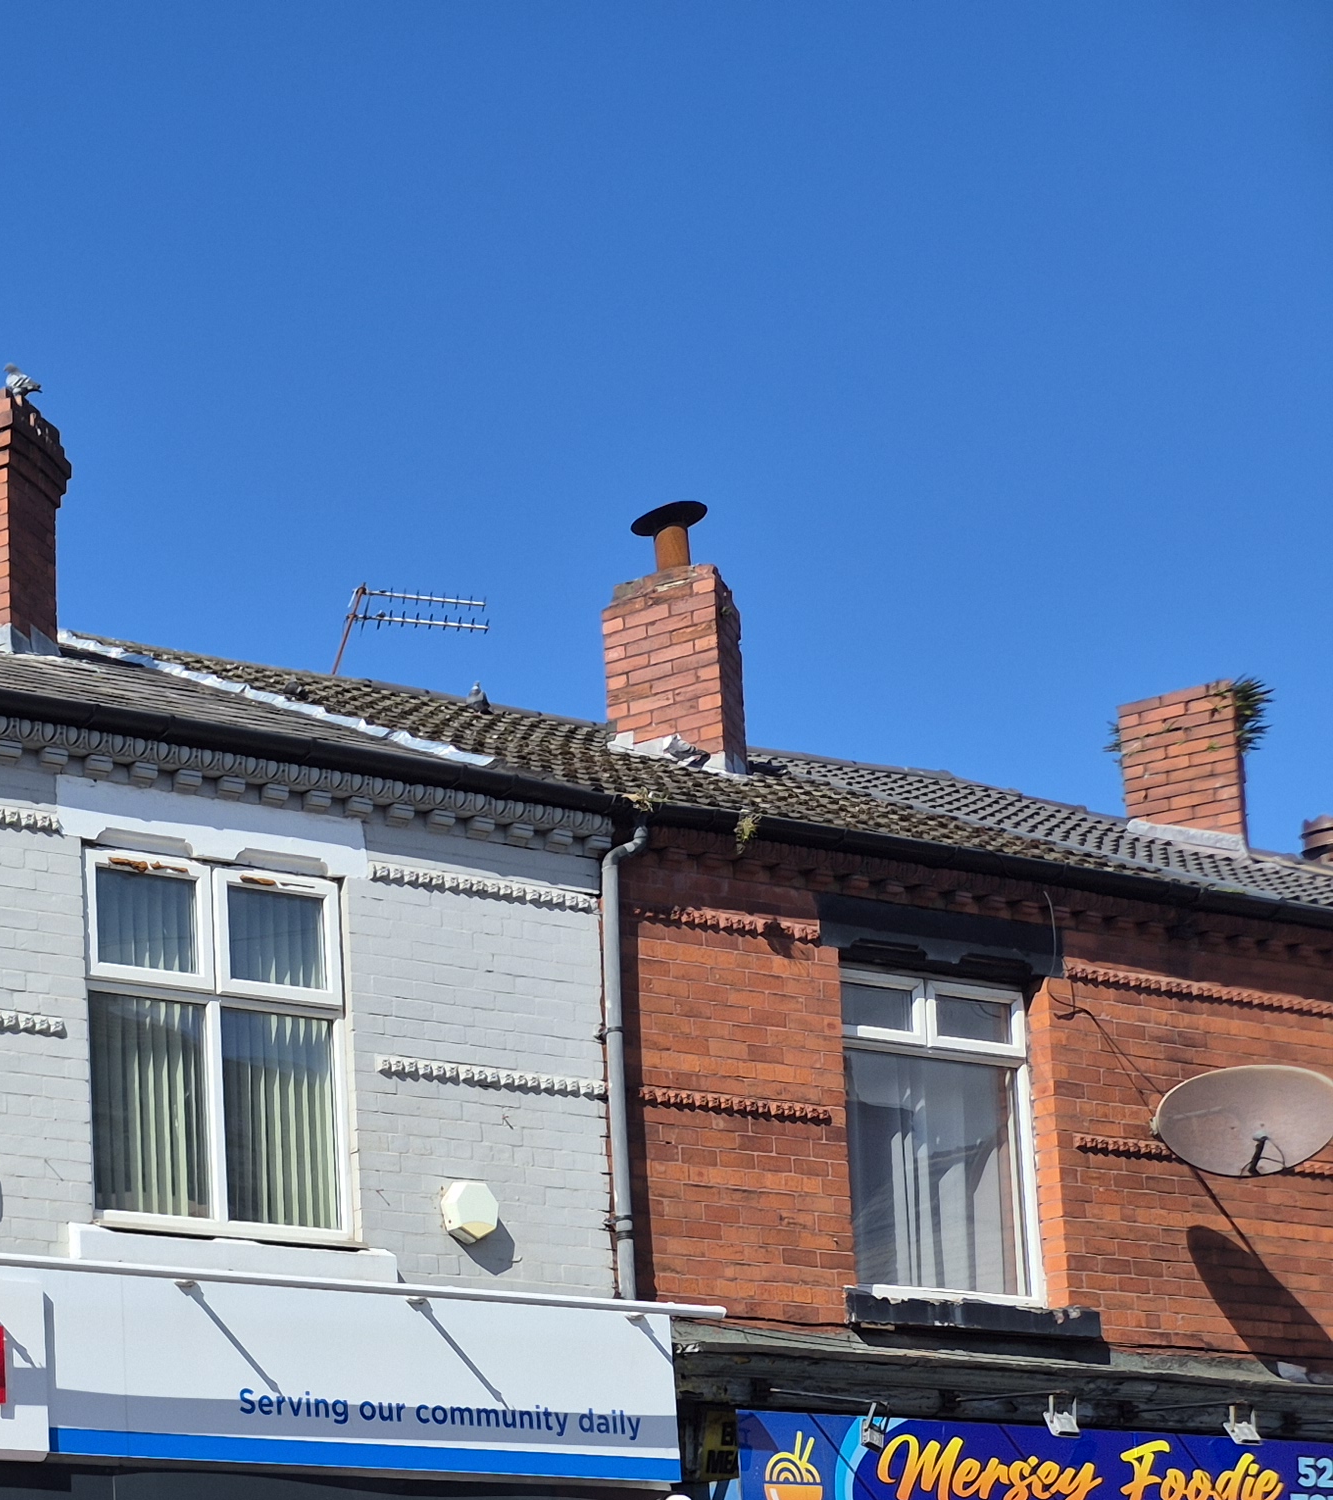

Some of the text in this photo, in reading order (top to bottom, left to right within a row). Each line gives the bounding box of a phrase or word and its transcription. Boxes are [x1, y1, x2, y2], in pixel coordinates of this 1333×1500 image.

[239, 1388, 641, 1440] Serving our community daily
